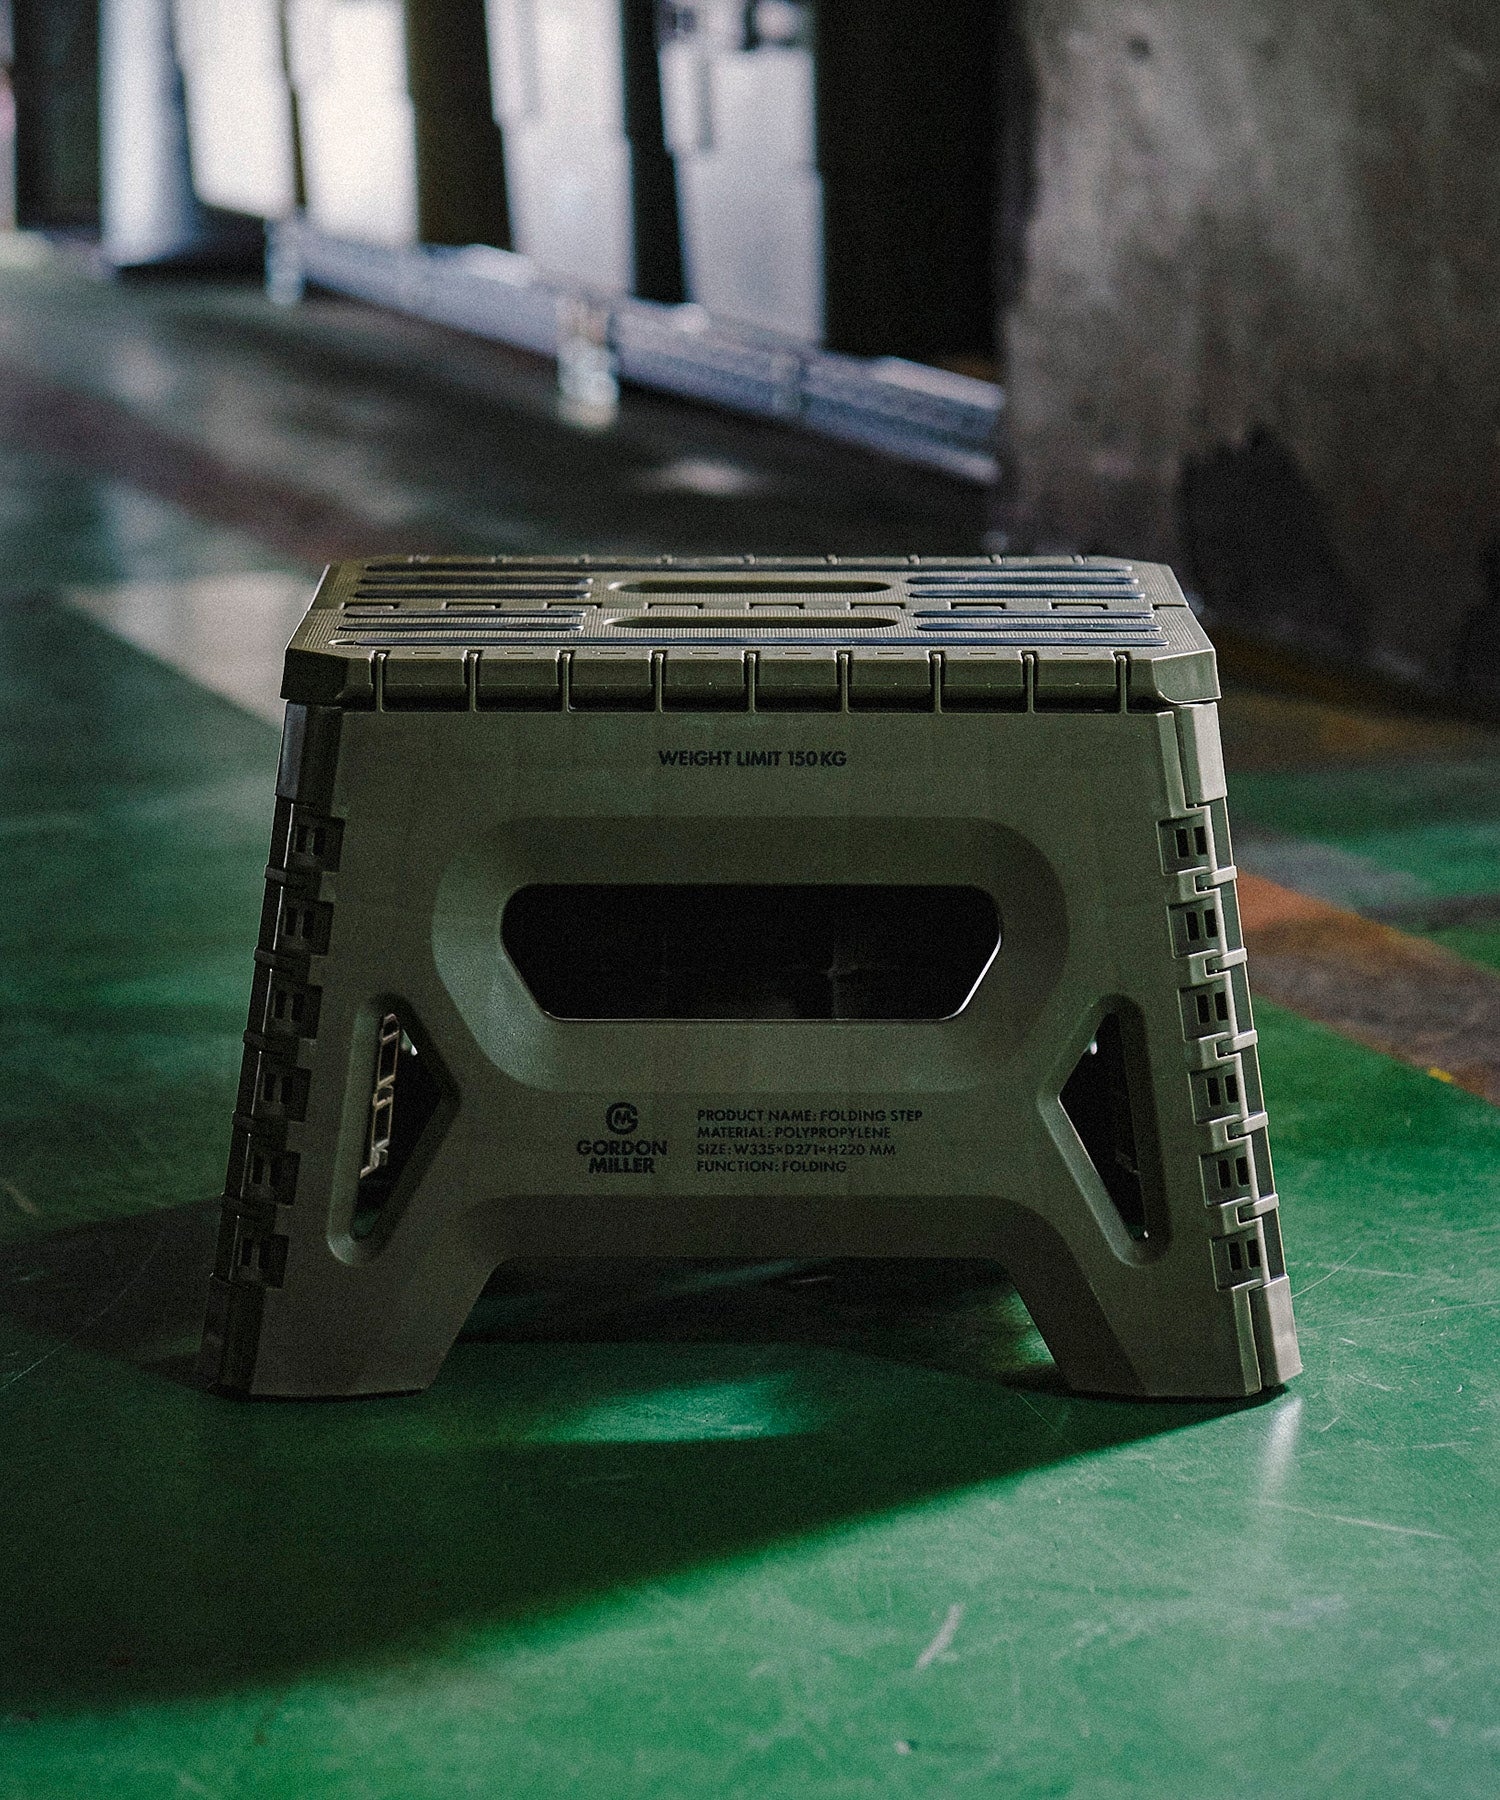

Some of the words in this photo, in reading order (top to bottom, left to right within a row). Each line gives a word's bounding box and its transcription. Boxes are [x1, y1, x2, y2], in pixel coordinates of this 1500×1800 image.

[658, 750, 732, 767] WEIGHT
[736, 750, 782, 767] LIMIT
[696, 1109, 764, 1122] PRODUCT
[768, 1109, 817, 1122] NAME:
[820, 1109, 887, 1122] FOLDING
[890, 1109, 923, 1122] STEP
[696, 1126, 771, 1139] MATERIAL:
[774, 1126, 891, 1139] POLYPROPYLENE
[576, 1139, 668, 1156] GORDON
[868, 1143, 897, 1156] MM
[588, 1157, 656, 1174] MILLER
[696, 1160, 779, 1173] FUNCTION:
[781, 1160, 847, 1173] FOLDING
